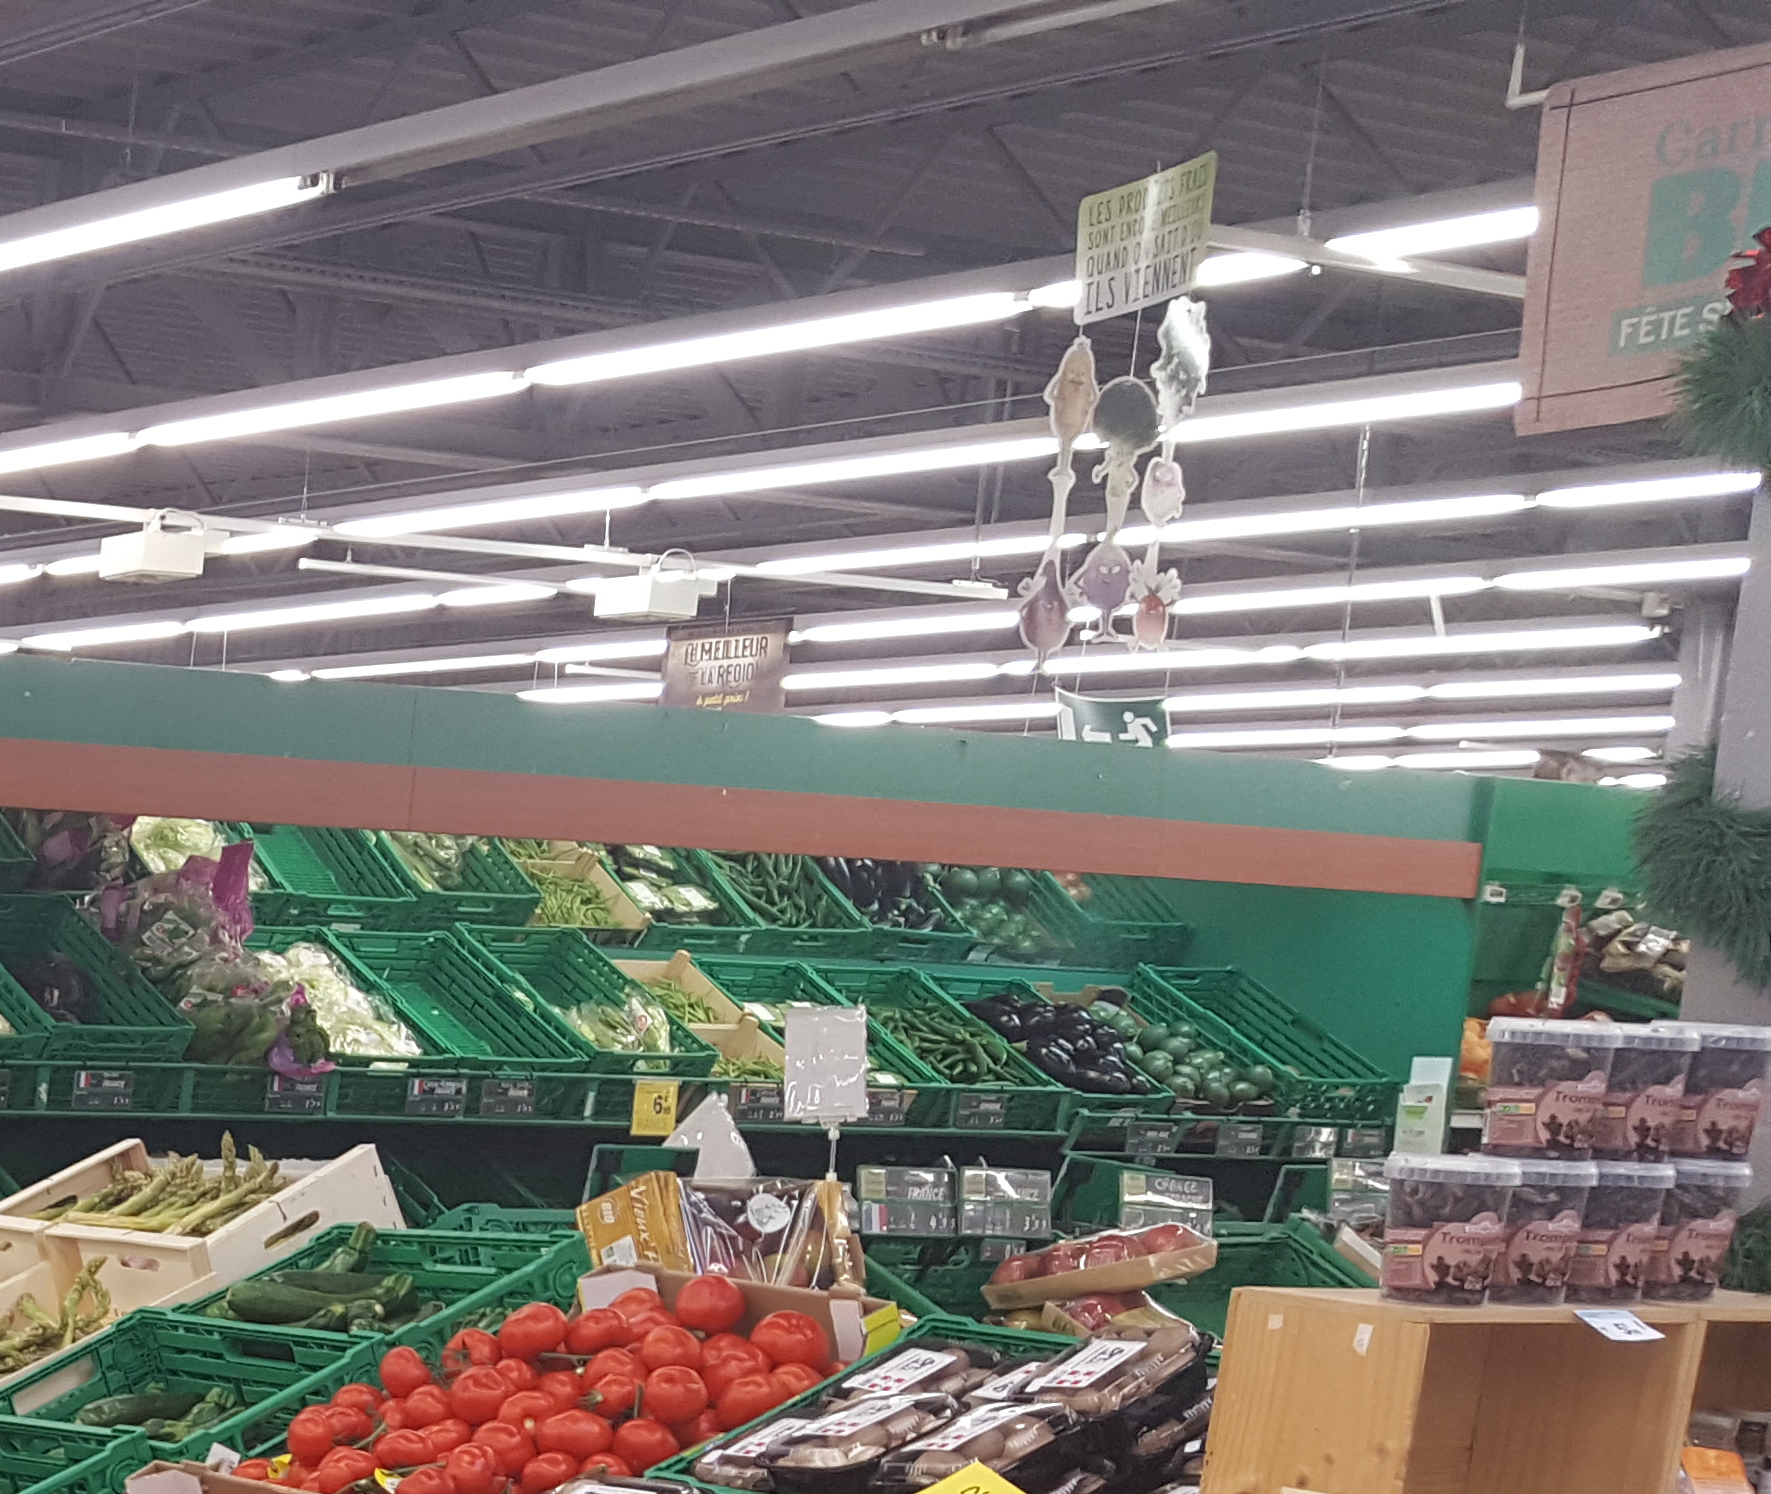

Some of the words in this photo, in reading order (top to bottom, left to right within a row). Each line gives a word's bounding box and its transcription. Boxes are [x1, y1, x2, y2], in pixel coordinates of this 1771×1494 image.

[1085, 277, 1115, 315] ILS
[1125, 247, 1196, 305] VIENNENT
[1619, 304, 1694, 348] FÊTE
